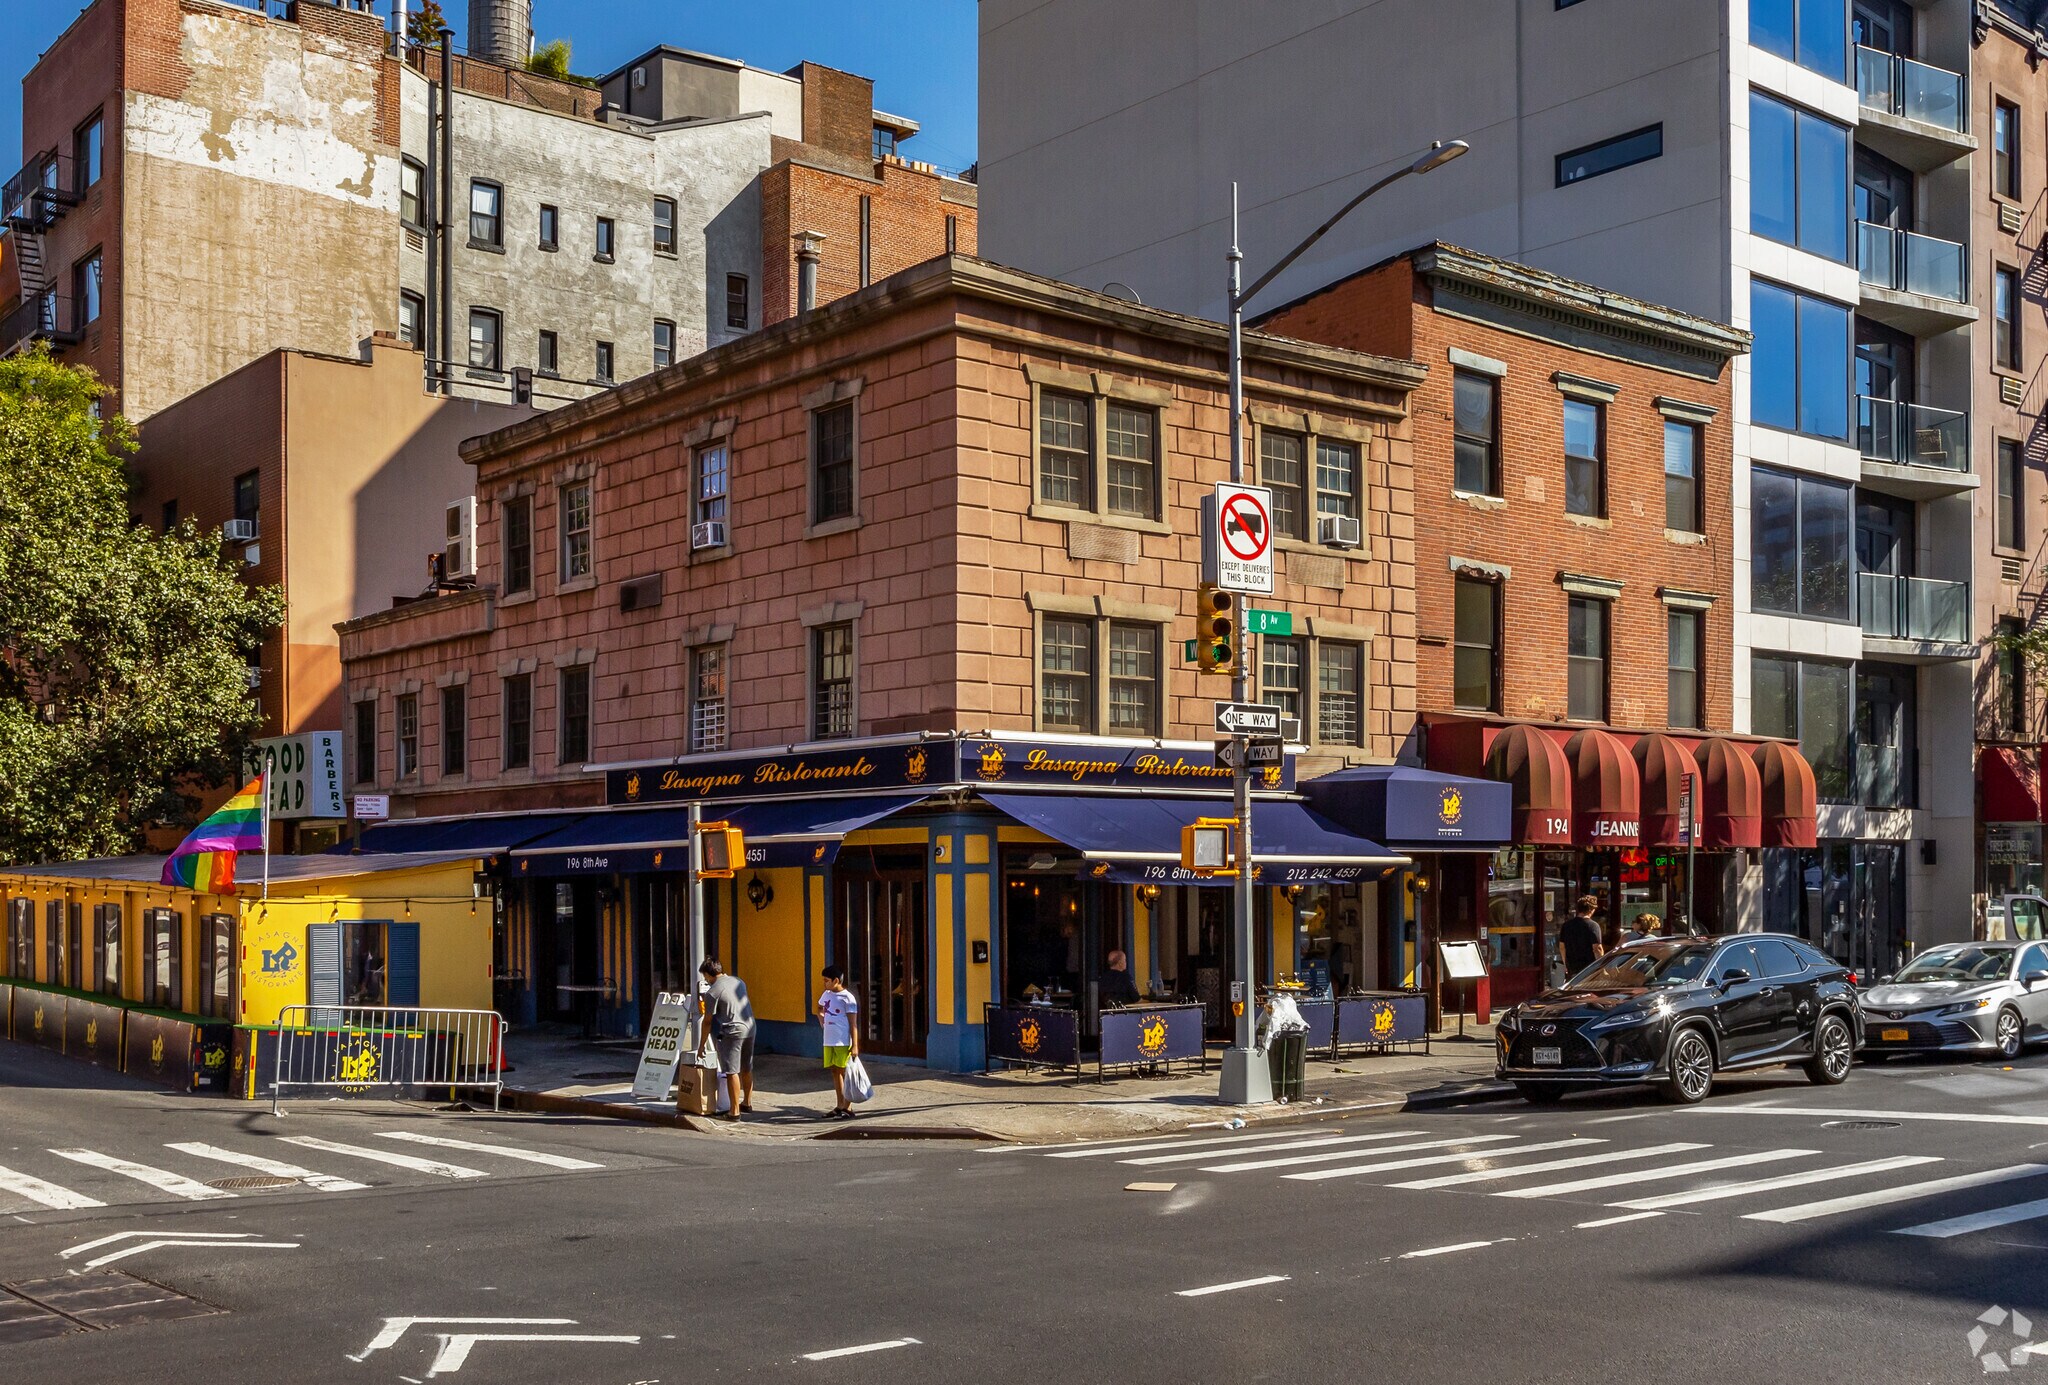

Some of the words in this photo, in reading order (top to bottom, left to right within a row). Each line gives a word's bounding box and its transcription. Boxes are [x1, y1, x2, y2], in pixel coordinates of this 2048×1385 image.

[1222, 561, 1240, 571] EXCEPT
[1243, 563, 1270, 575] DELIVERIES
[1227, 572, 1241, 582] THIS
[1245, 574, 1265, 584] BLOCK
[1260, 613, 1267, 630] 8
[1270, 614, 1278, 625] Av
[1225, 713, 1244, 725] ONE
[1252, 713, 1272, 727] WAY
[1253, 747, 1274, 759] WAY
[1023, 749, 1122, 781] Lasagna
[322, 737, 341, 811] BARBERS
[660, 770, 745, 795] Lasagna
[753, 756, 878, 785] Ristorante
[1546, 818, 1568, 835] 194
[745, 848, 766, 862] 4551
[567, 857, 580, 869] 196
[582, 857, 594, 869] 8th
[594, 856, 608, 868] Ave
[1144, 866, 1166, 879] 196
[1171, 867, 1191, 879] 8th
[1286, 868, 1308, 880] 212.
[1310, 867, 1332, 880] 242.
[1335, 867, 1362, 878] 4551
[250, 931, 304, 950] LASAGNA
[650, 1025, 680, 1039] GOOD
[647, 1038, 676, 1051] HEAD
